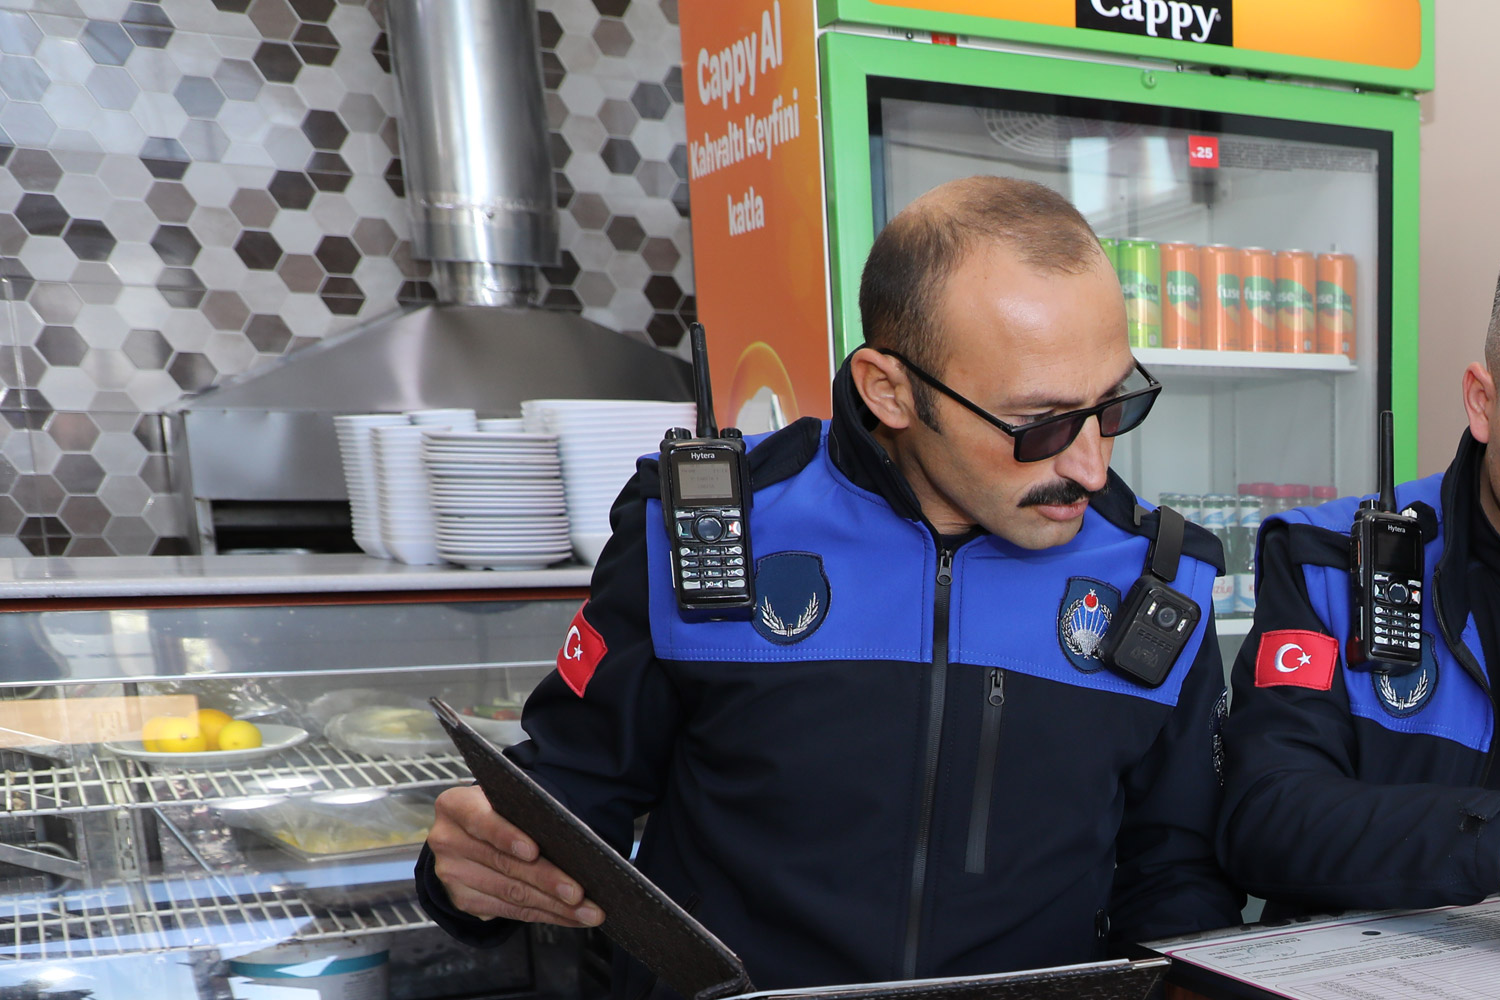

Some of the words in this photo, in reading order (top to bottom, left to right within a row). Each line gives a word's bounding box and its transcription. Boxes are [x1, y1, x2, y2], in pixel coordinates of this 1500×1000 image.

[697, 31, 757, 111] Cappy
[690, 120, 745, 180] Kahvaltı
[745, 87, 800, 161] Keyfini
[727, 186, 765, 236] katla
[1167, 281, 1195, 296] fuse
[690, 452, 715, 461] Hytera
[1387, 524, 1406, 534] Hytera
